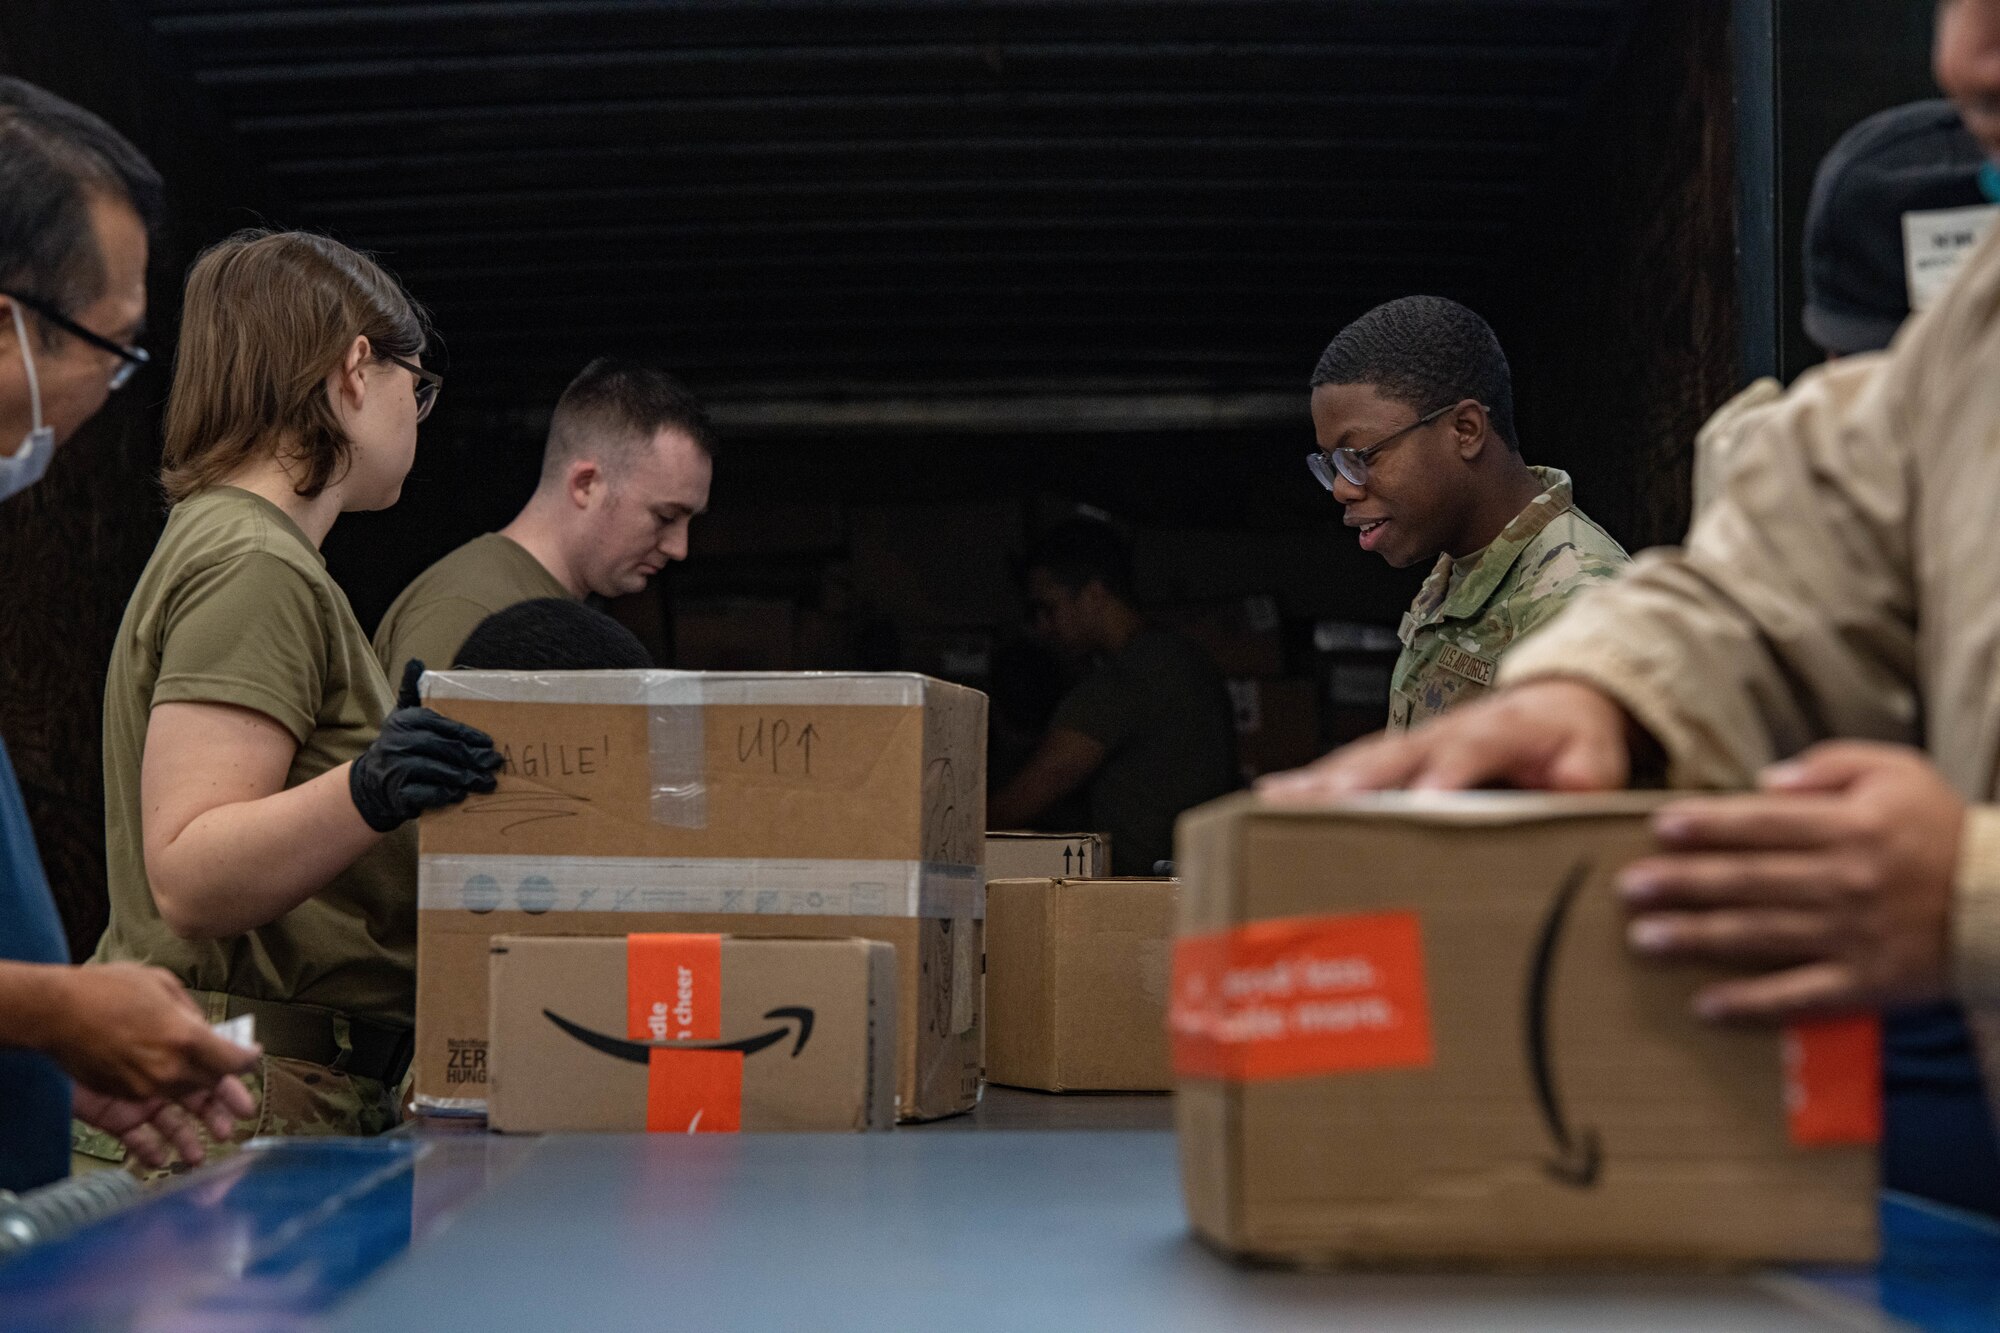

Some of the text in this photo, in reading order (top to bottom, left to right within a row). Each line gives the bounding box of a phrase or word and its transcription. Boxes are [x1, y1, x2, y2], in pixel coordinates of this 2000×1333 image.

[1439, 645, 1491, 681] U.S. AIR ORCE
[502, 734, 609, 776] AGILE!
[737, 717, 790, 774] UP
[672, 965, 693, 1026] cheer
[447, 1070, 487, 1084] HUNG
[448, 1049, 487, 1068] ZER
